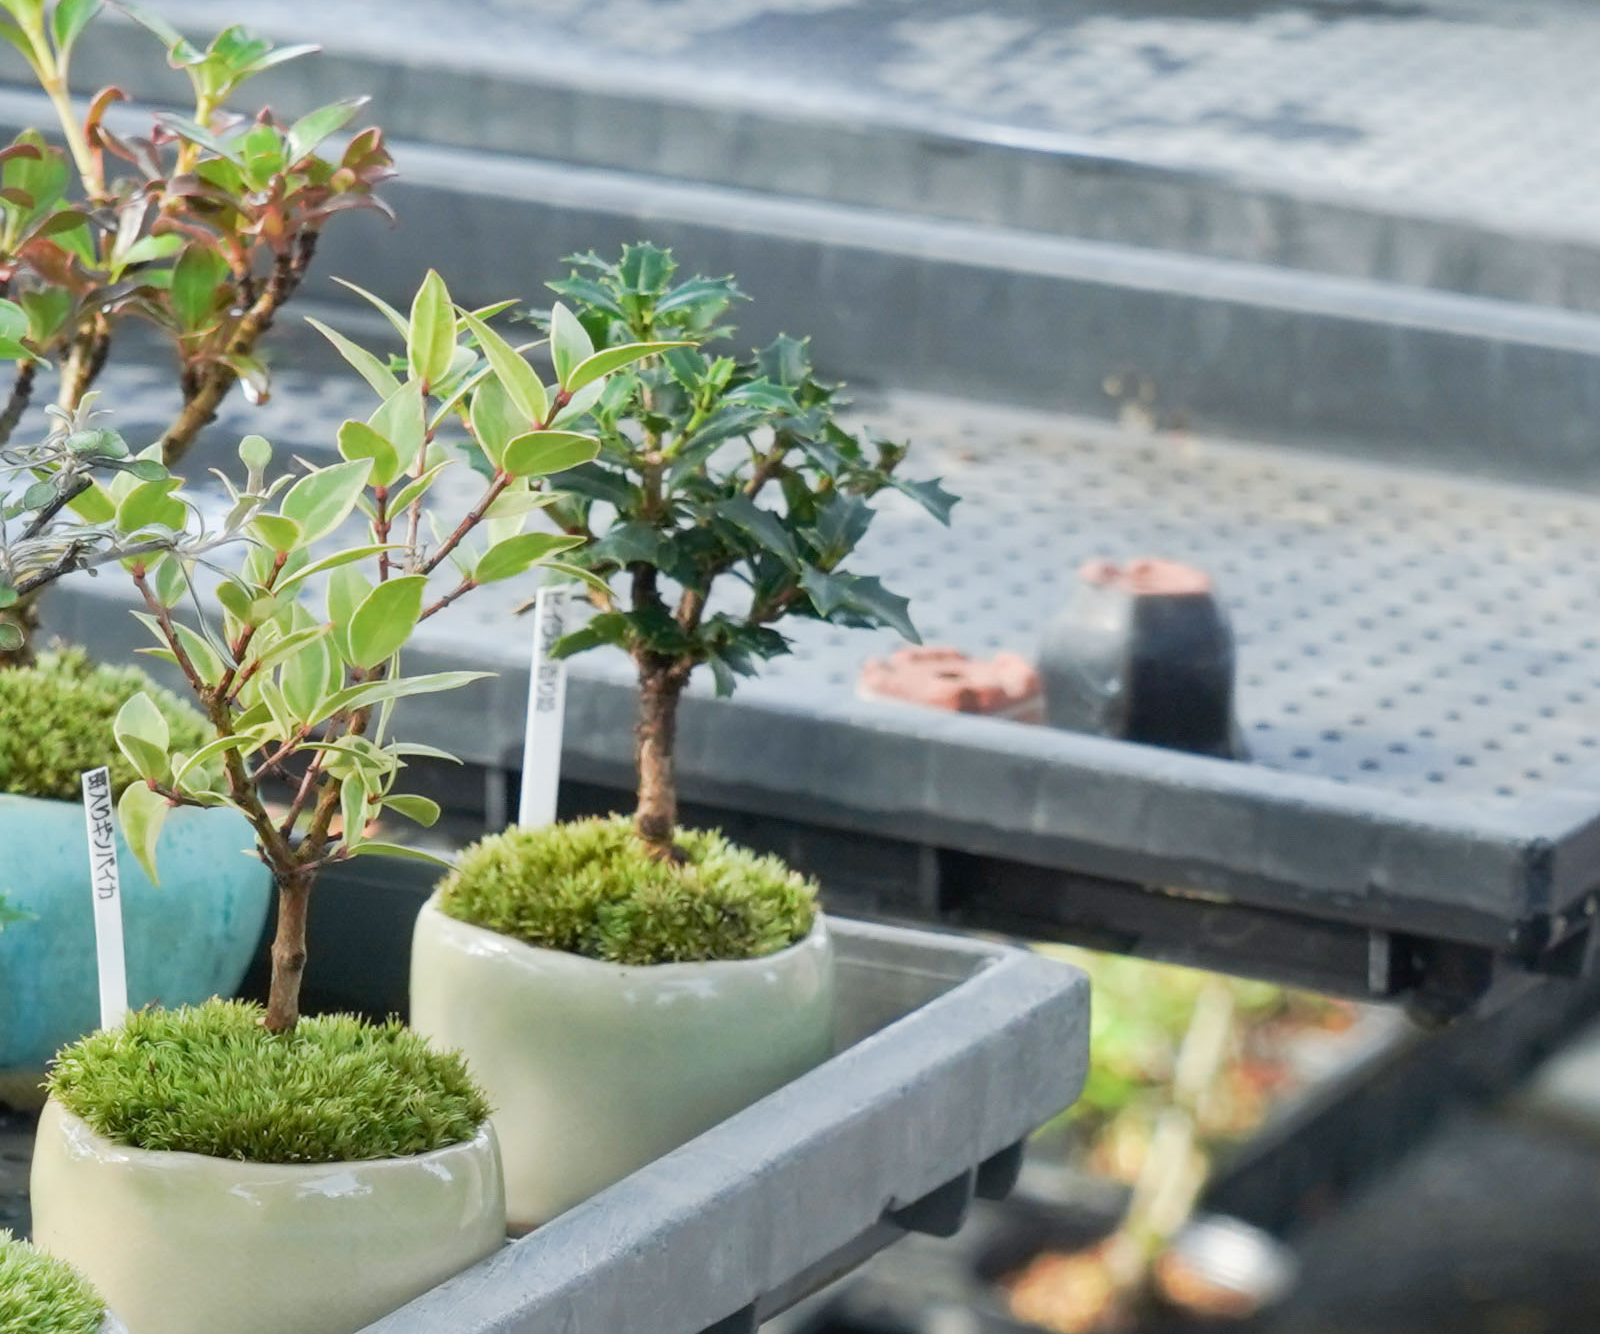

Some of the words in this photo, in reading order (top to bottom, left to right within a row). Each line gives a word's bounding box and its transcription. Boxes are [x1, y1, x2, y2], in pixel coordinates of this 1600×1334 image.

[87, 769, 117, 900] 斑入りギンバイカ
